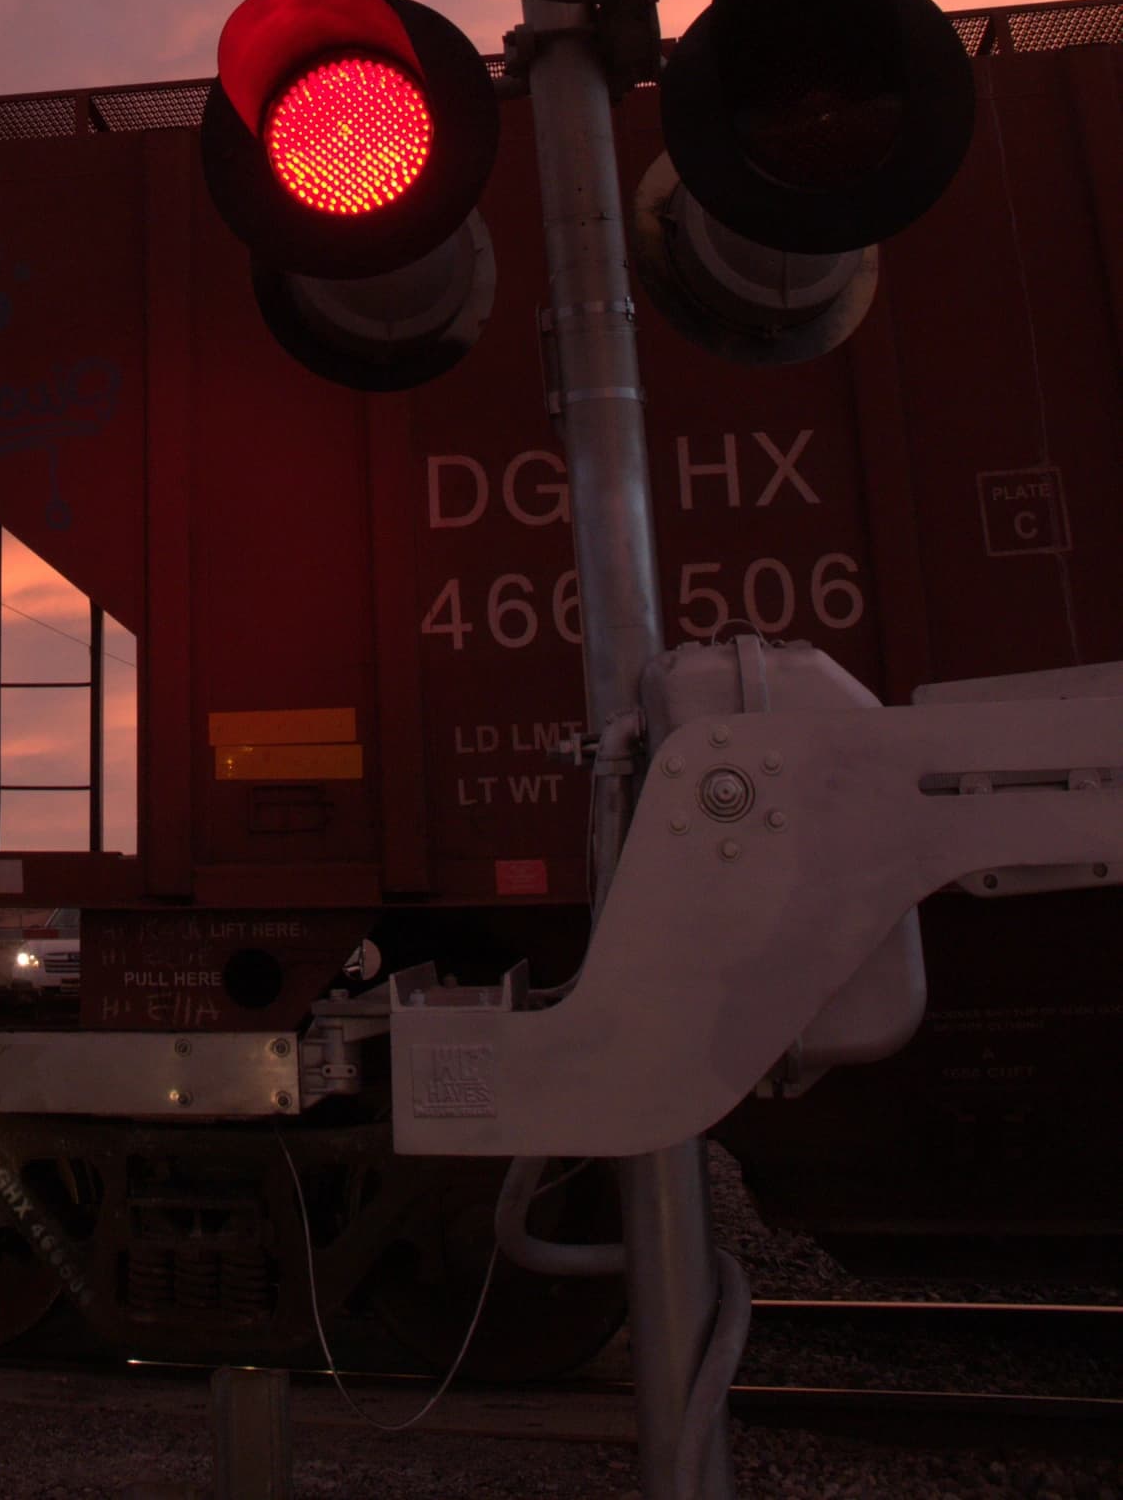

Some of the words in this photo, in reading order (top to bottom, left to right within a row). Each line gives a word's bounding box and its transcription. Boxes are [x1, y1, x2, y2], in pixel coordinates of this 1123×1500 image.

[426, 449, 574, 529] DG
[676, 428, 822, 511] HX
[991, 483, 1051, 501] PLATE
[1014, 511, 1039, 540] C
[678, 552, 865, 639] 506
[454, 724, 500, 756] LD
[457, 776, 498, 807] LT
[508, 773, 564, 804] WT
[210, 921, 247, 939] LIFT
[251, 921, 302, 939] HERE
[123, 971, 170, 988] PULL
[173, 971, 223, 988] HERE
